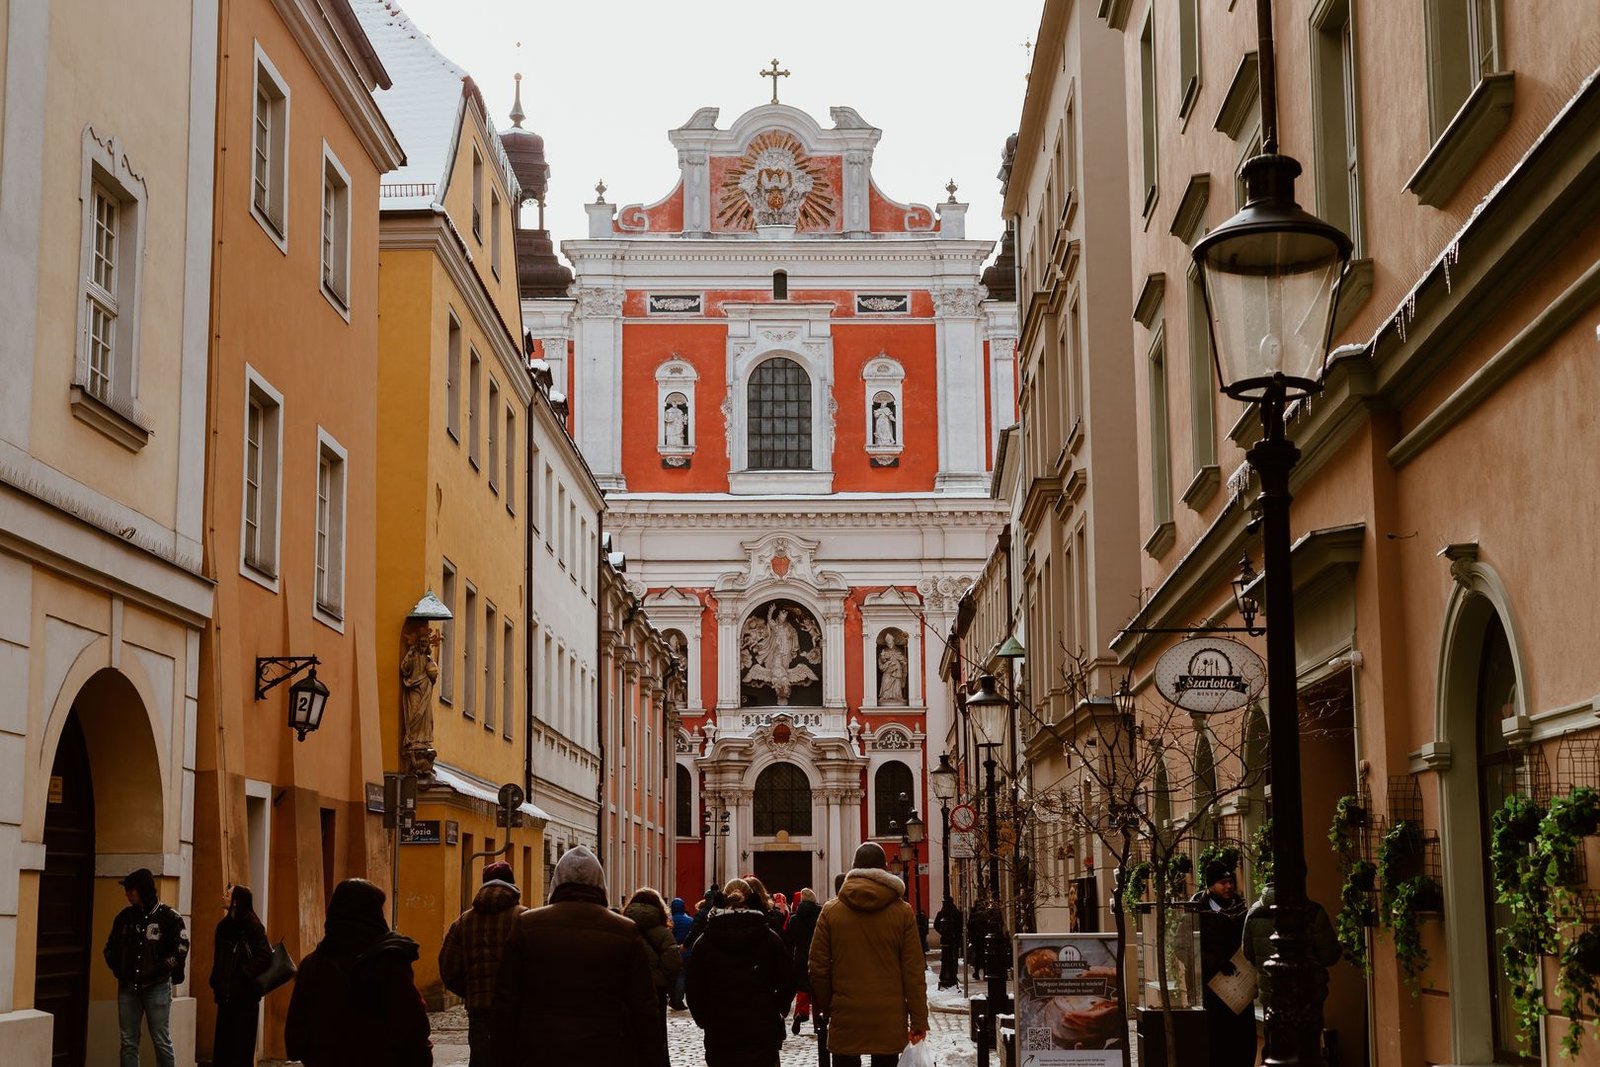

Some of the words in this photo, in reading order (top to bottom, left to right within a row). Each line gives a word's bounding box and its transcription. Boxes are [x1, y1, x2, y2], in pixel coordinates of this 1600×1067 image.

[1187, 677, 1235, 689] Szarlotta
[298, 697, 308, 711] 2
[410, 828, 431, 836] Kozia
